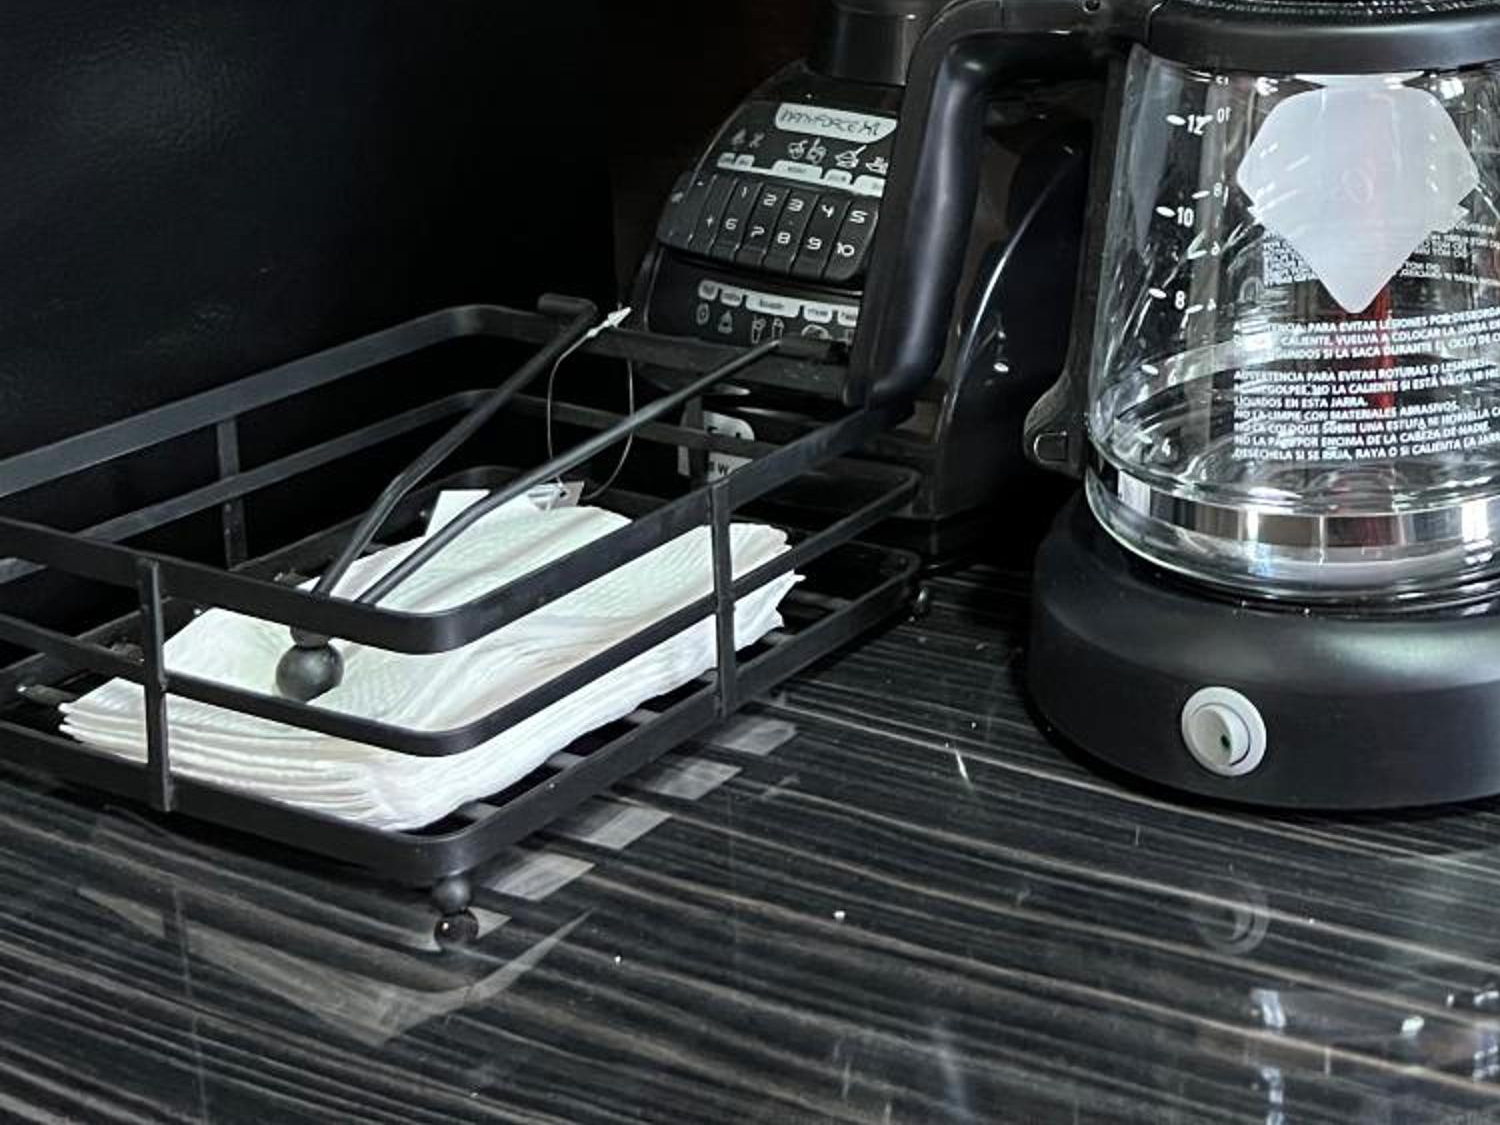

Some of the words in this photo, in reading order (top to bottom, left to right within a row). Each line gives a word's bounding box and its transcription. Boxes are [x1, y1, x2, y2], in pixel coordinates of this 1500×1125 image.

[763, 194, 777, 206] 2
[788, 198, 804, 212] 3
[821, 204, 835, 218] 4
[850, 210, 868, 223] 5
[1177, 206, 1194, 227] 10
[725, 218, 738, 230] 6
[751, 226, 765, 238] 7
[777, 232, 791, 244] 8
[806, 237, 822, 250] 9
[837, 242, 855, 256] 10
[1174, 290, 1186, 310] 8
[1308, 322, 1337, 332] PARA
[1339, 320, 1377, 332] EVITAR
[1336, 335, 1379, 346] VUELVA
[1392, 328, 1441, 342] COLOCAR
[1443, 326, 1456, 337] LA
[1335, 348, 1349, 358] LA
[1352, 346, 1381, 358] SACA
[1338, 369, 1377, 382] EVITAR
[1332, 383, 1346, 394] LA
[1349, 380, 1399, 394] CALIENTE
[1285, 397, 1298, 408] EN
[1302, 396, 1328, 408] ESTA
[1304, 410, 1328, 421] CON
[1359, 421, 1384, 433] UNA
[1356, 448, 1386, 459] RAYA
[1388, 446, 1398, 457] O
